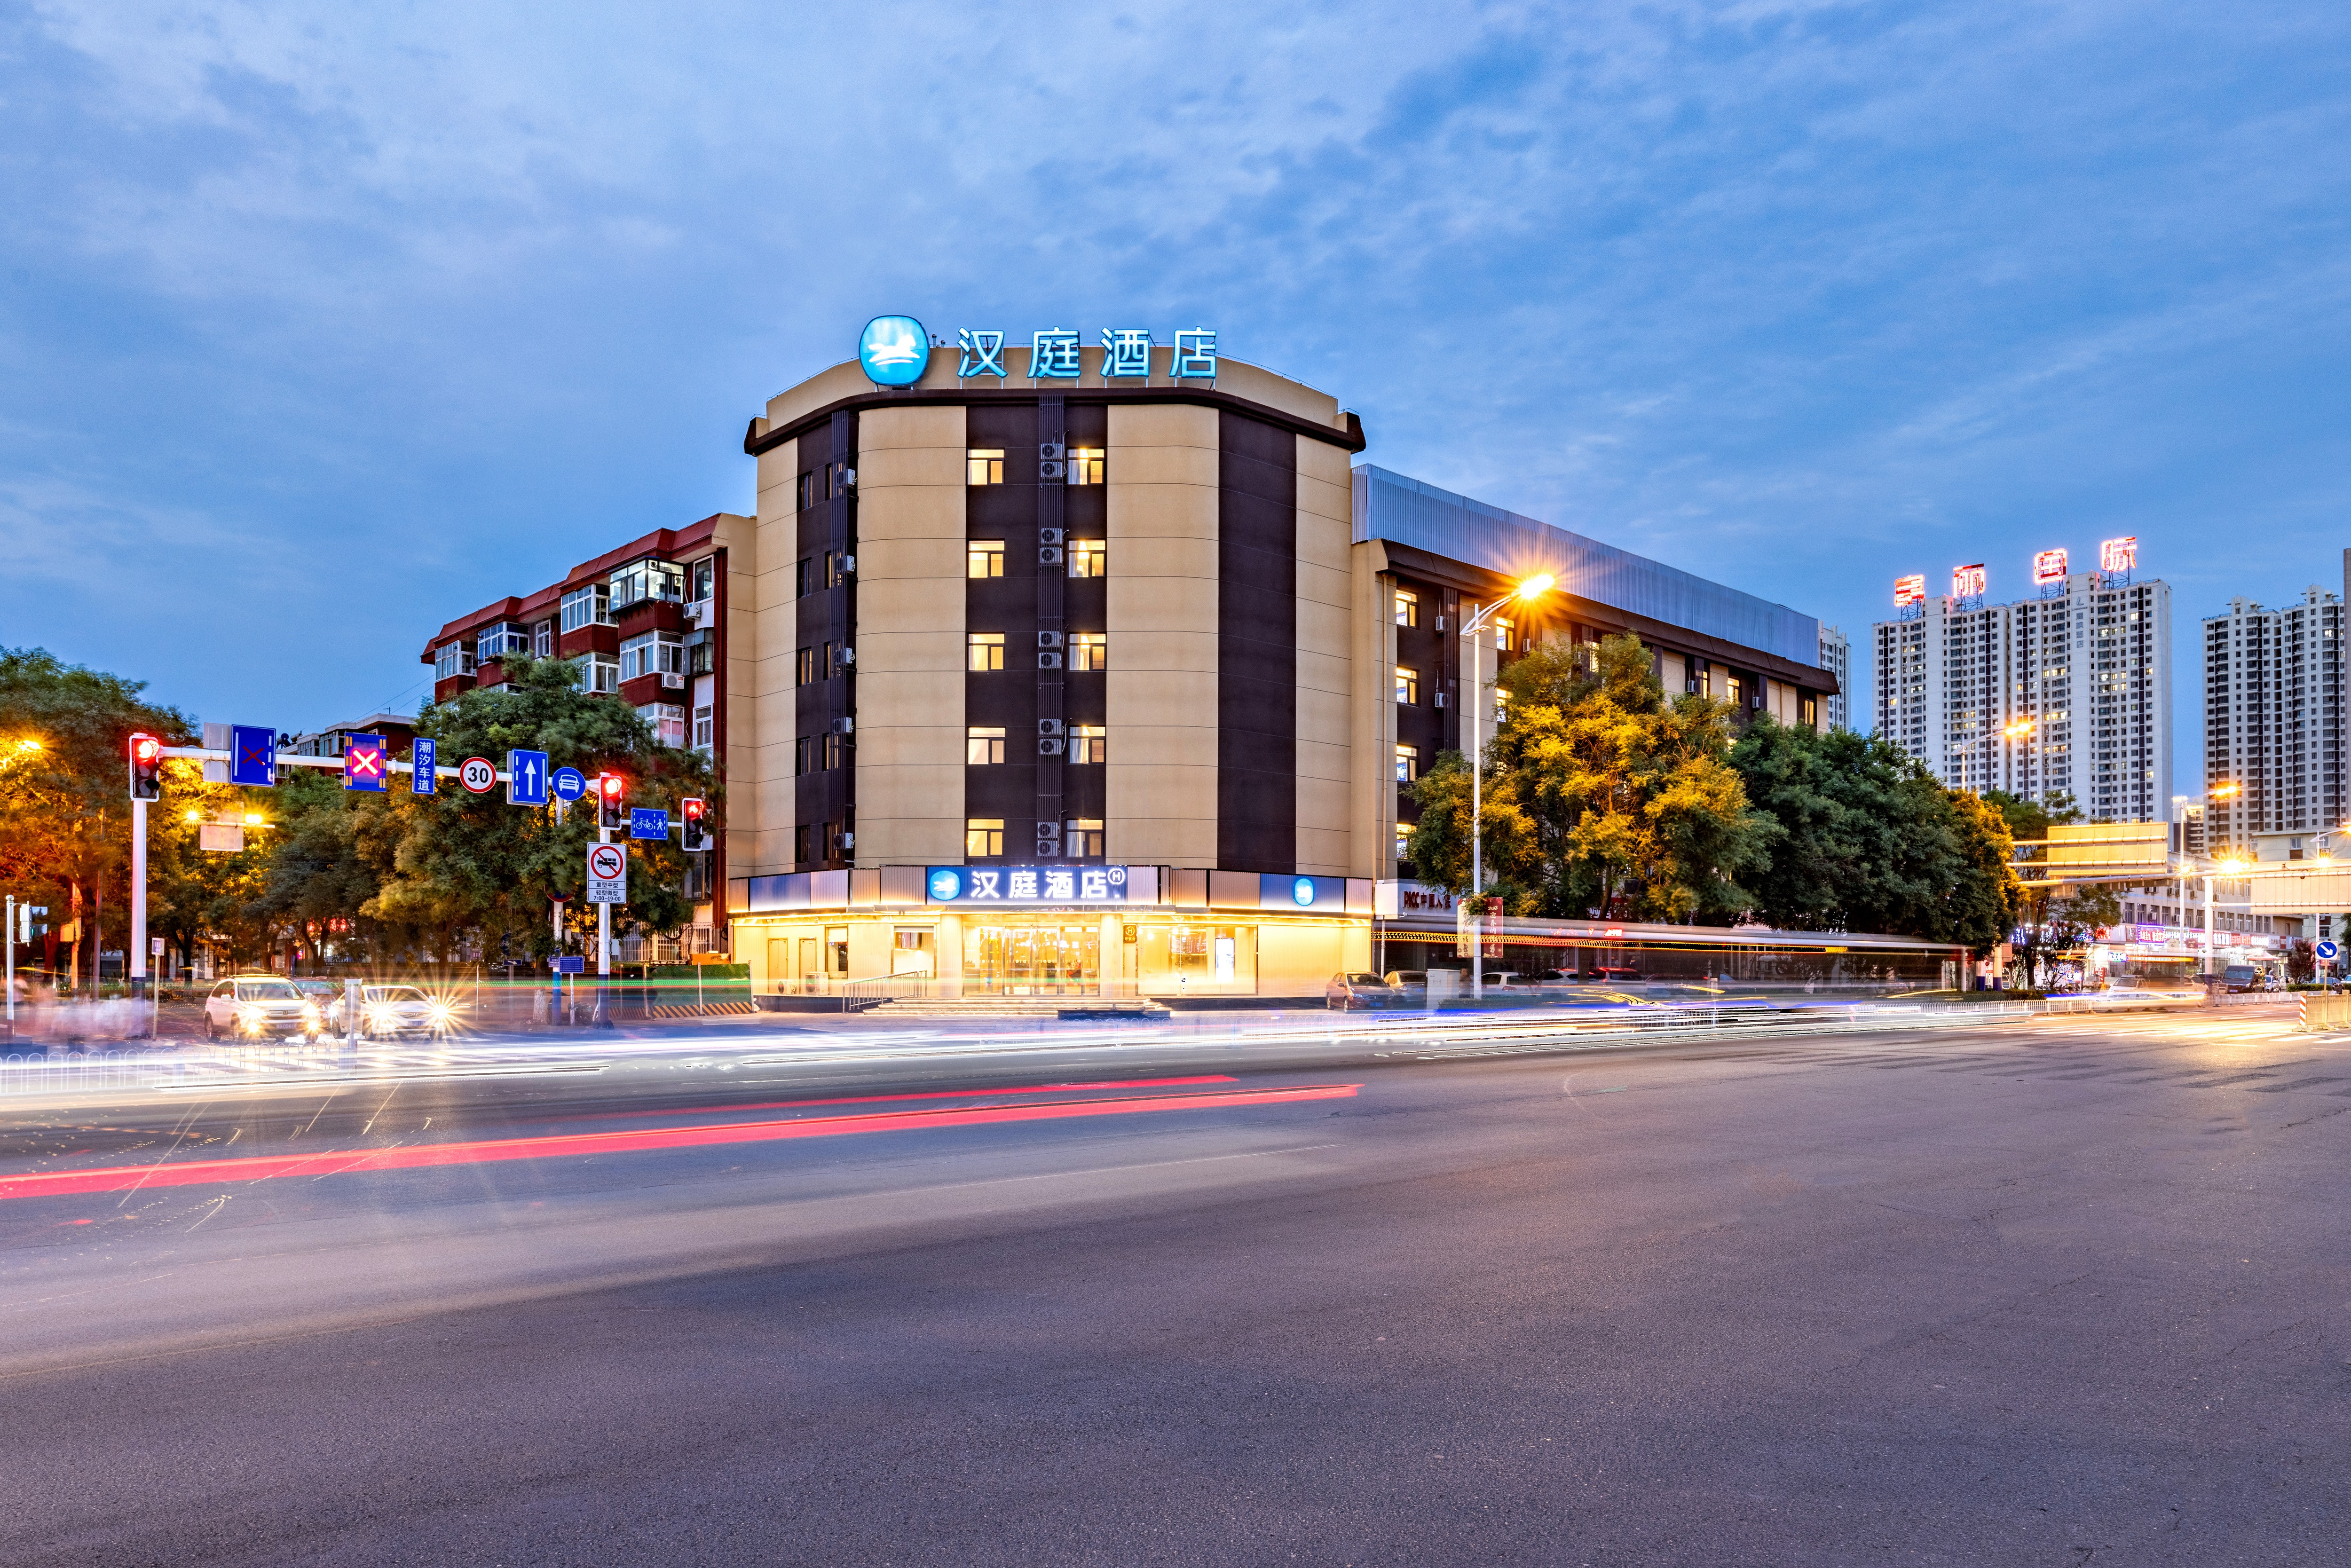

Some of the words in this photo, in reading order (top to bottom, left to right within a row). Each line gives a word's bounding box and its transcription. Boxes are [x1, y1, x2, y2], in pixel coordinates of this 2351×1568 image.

[957, 326, 1216, 378] 汉庭酒店
[418, 741, 431, 791] 潮汐车道
[468, 767, 489, 783] 30
[970, 871, 1106, 898] 汉庭酒店
